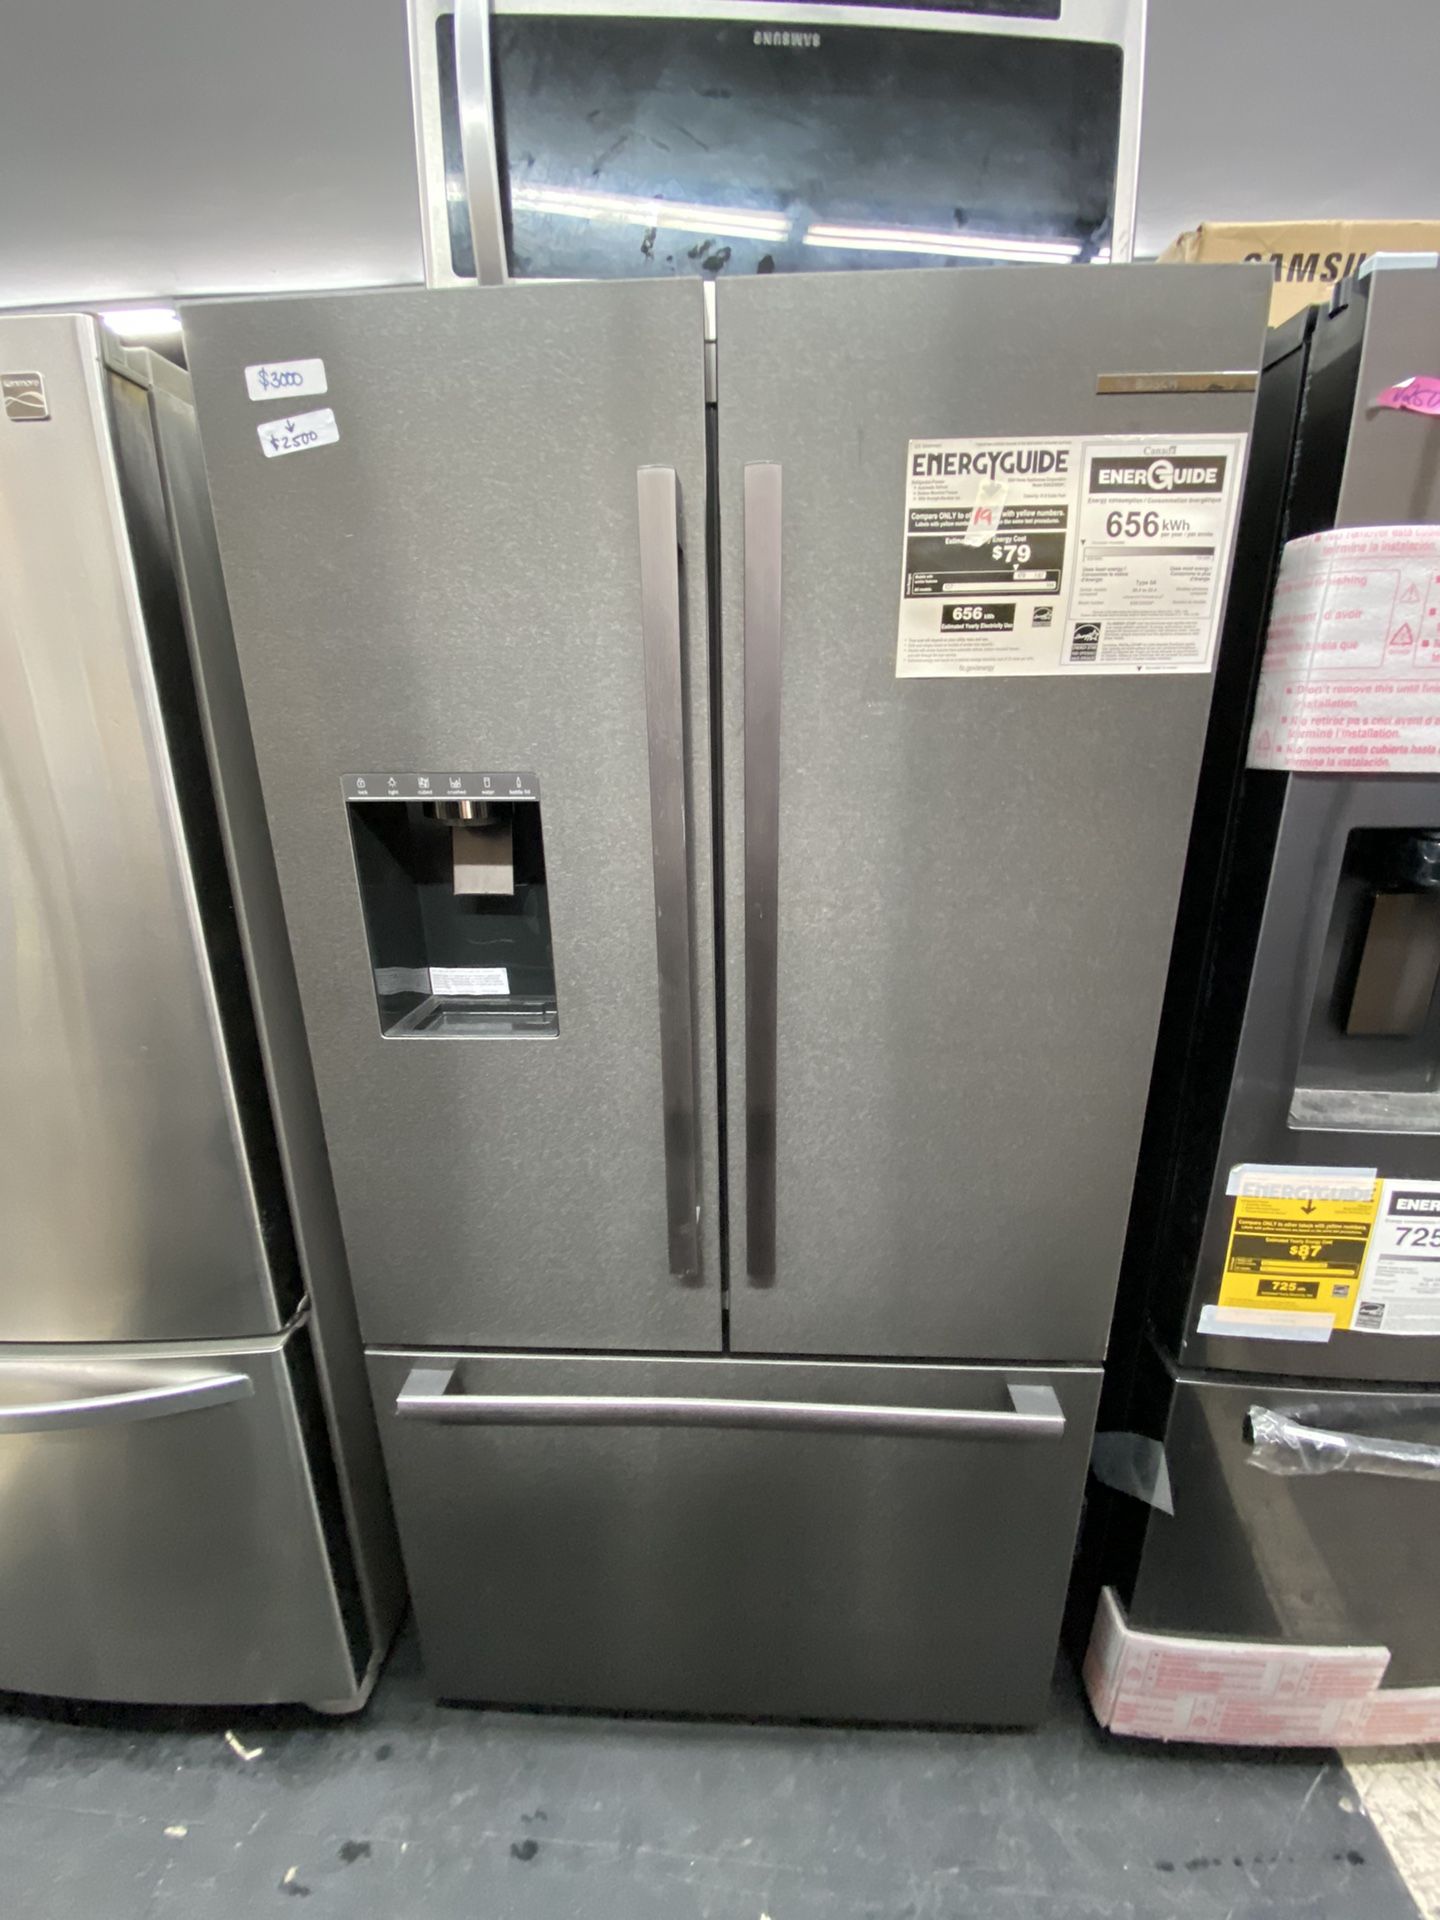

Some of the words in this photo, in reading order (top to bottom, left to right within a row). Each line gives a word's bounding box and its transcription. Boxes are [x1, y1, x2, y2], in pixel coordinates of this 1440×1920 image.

[752, 31, 820, 47] SAMSUNG
[258, 367, 305, 391] $3000
[270, 430, 318, 451] $2500
[912, 449, 1070, 481] ENERGYGUIDE
[1098, 459, 1218, 490] ENERGUIDE
[911, 512, 938, 521] Compare
[939, 512, 957, 520] ONLY
[1016, 510, 1036, 518] yellow
[1037, 509, 1065, 517] numbers.
[1106, 511, 1160, 538] 656
[1162, 519, 1190, 531] kWh
[992, 536, 1012, 544] Energy
[992, 545, 1031, 562] $79
[952, 607, 982, 620] 656
[1396, 1227, 1440, 1248] 725
[1289, 1245, 1322, 1257] $87
[1272, 1281, 1296, 1291] 725
